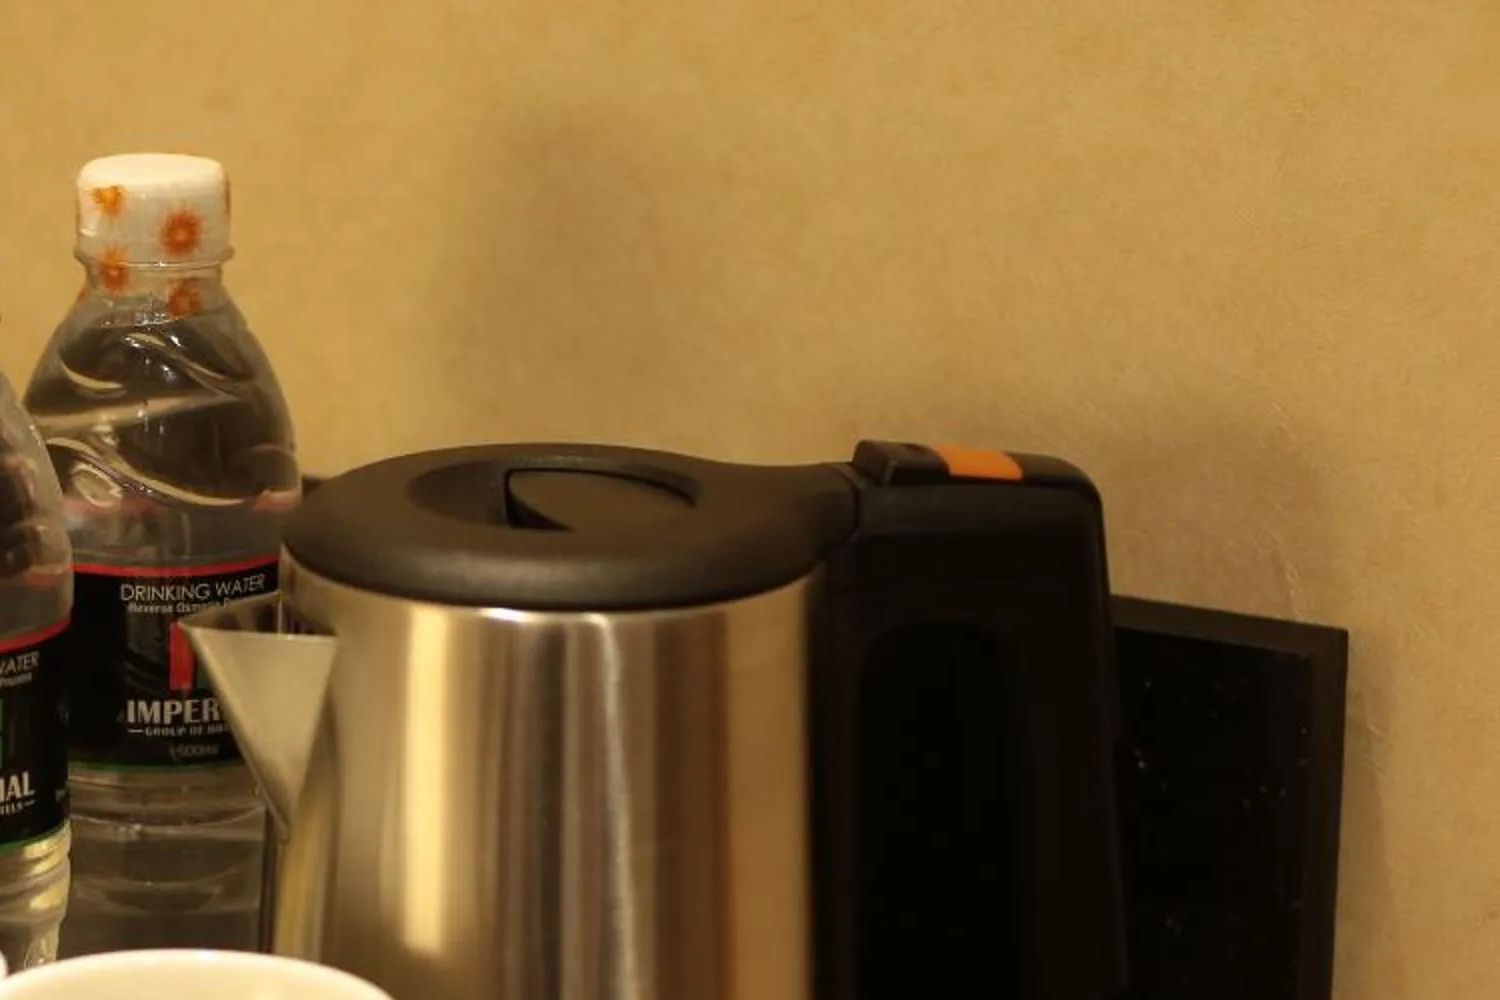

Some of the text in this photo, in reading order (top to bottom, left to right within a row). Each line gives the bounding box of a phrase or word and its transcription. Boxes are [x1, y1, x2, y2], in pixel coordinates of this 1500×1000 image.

[120, 572, 267, 601] DRINKING WATER
[126, 696, 222, 725] IMPER
